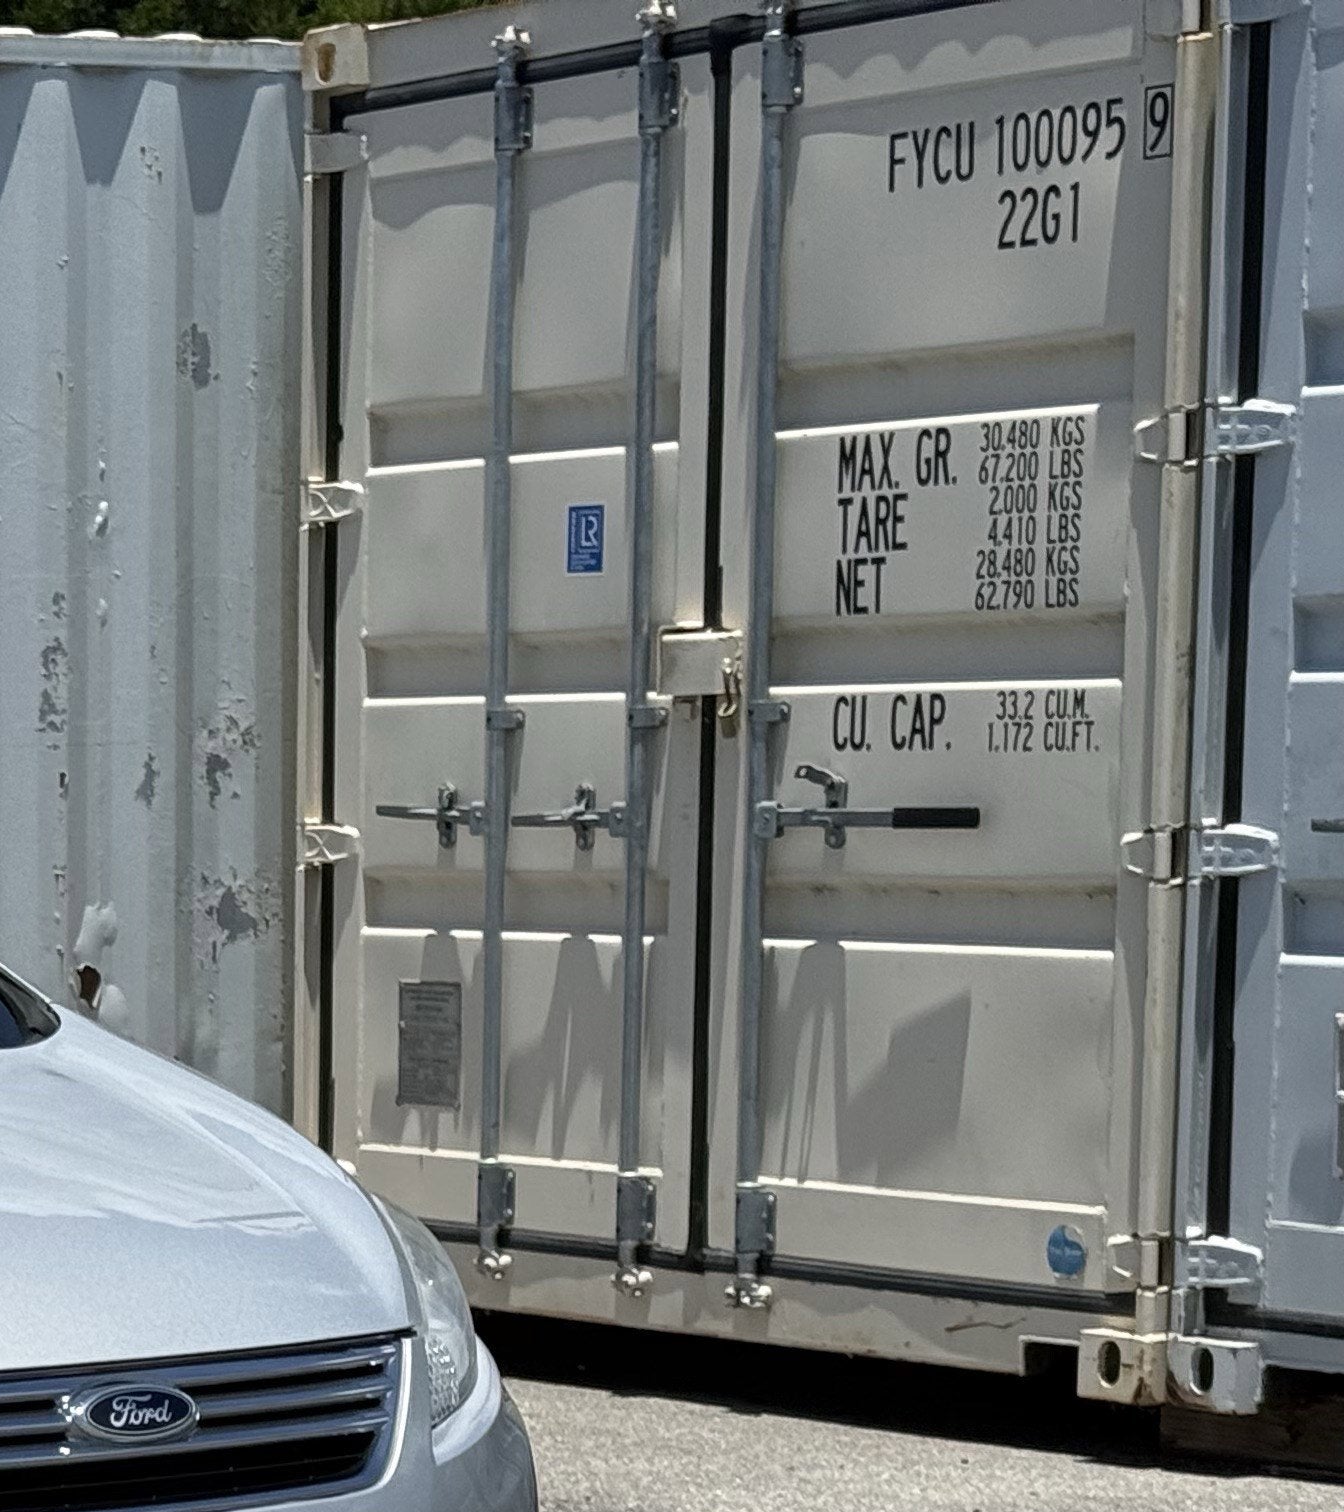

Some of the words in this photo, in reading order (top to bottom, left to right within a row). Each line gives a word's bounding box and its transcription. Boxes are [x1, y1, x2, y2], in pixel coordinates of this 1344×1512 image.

[888, 121, 975, 192] FYCU
[996, 98, 1126, 176] 100095
[1148, 92, 1170, 151] 9
[997, 182, 1080, 249] 22G1
[838, 432, 900, 493] MAX.
[916, 428, 957, 487] GR.
[979, 419, 1040, 452] 30.480
[1050, 416, 1085, 447] KGS
[978, 453, 1039, 485] 67.200
[1049, 449, 1084, 481] LBS
[838, 493, 908, 554] TARE
[989, 485, 1037, 516] 2.000
[1047, 481, 1082, 513] KGS
[988, 517, 1036, 547] 4.410
[1046, 514, 1081, 544] LBS
[836, 557, 886, 616] NET
[975, 549, 1036, 580] 28.480
[1045, 546, 1080, 576] KGS
[974, 581, 1034, 611] 62.790
[1044, 578, 1079, 608] LBS
[833, 696, 871, 751] CU.
[891, 693, 952, 751] CAP.
[995, 690, 1033, 720] 33.2
[988, 722, 1033, 752] 1.172
[111, 1394, 172, 1428] Ford
